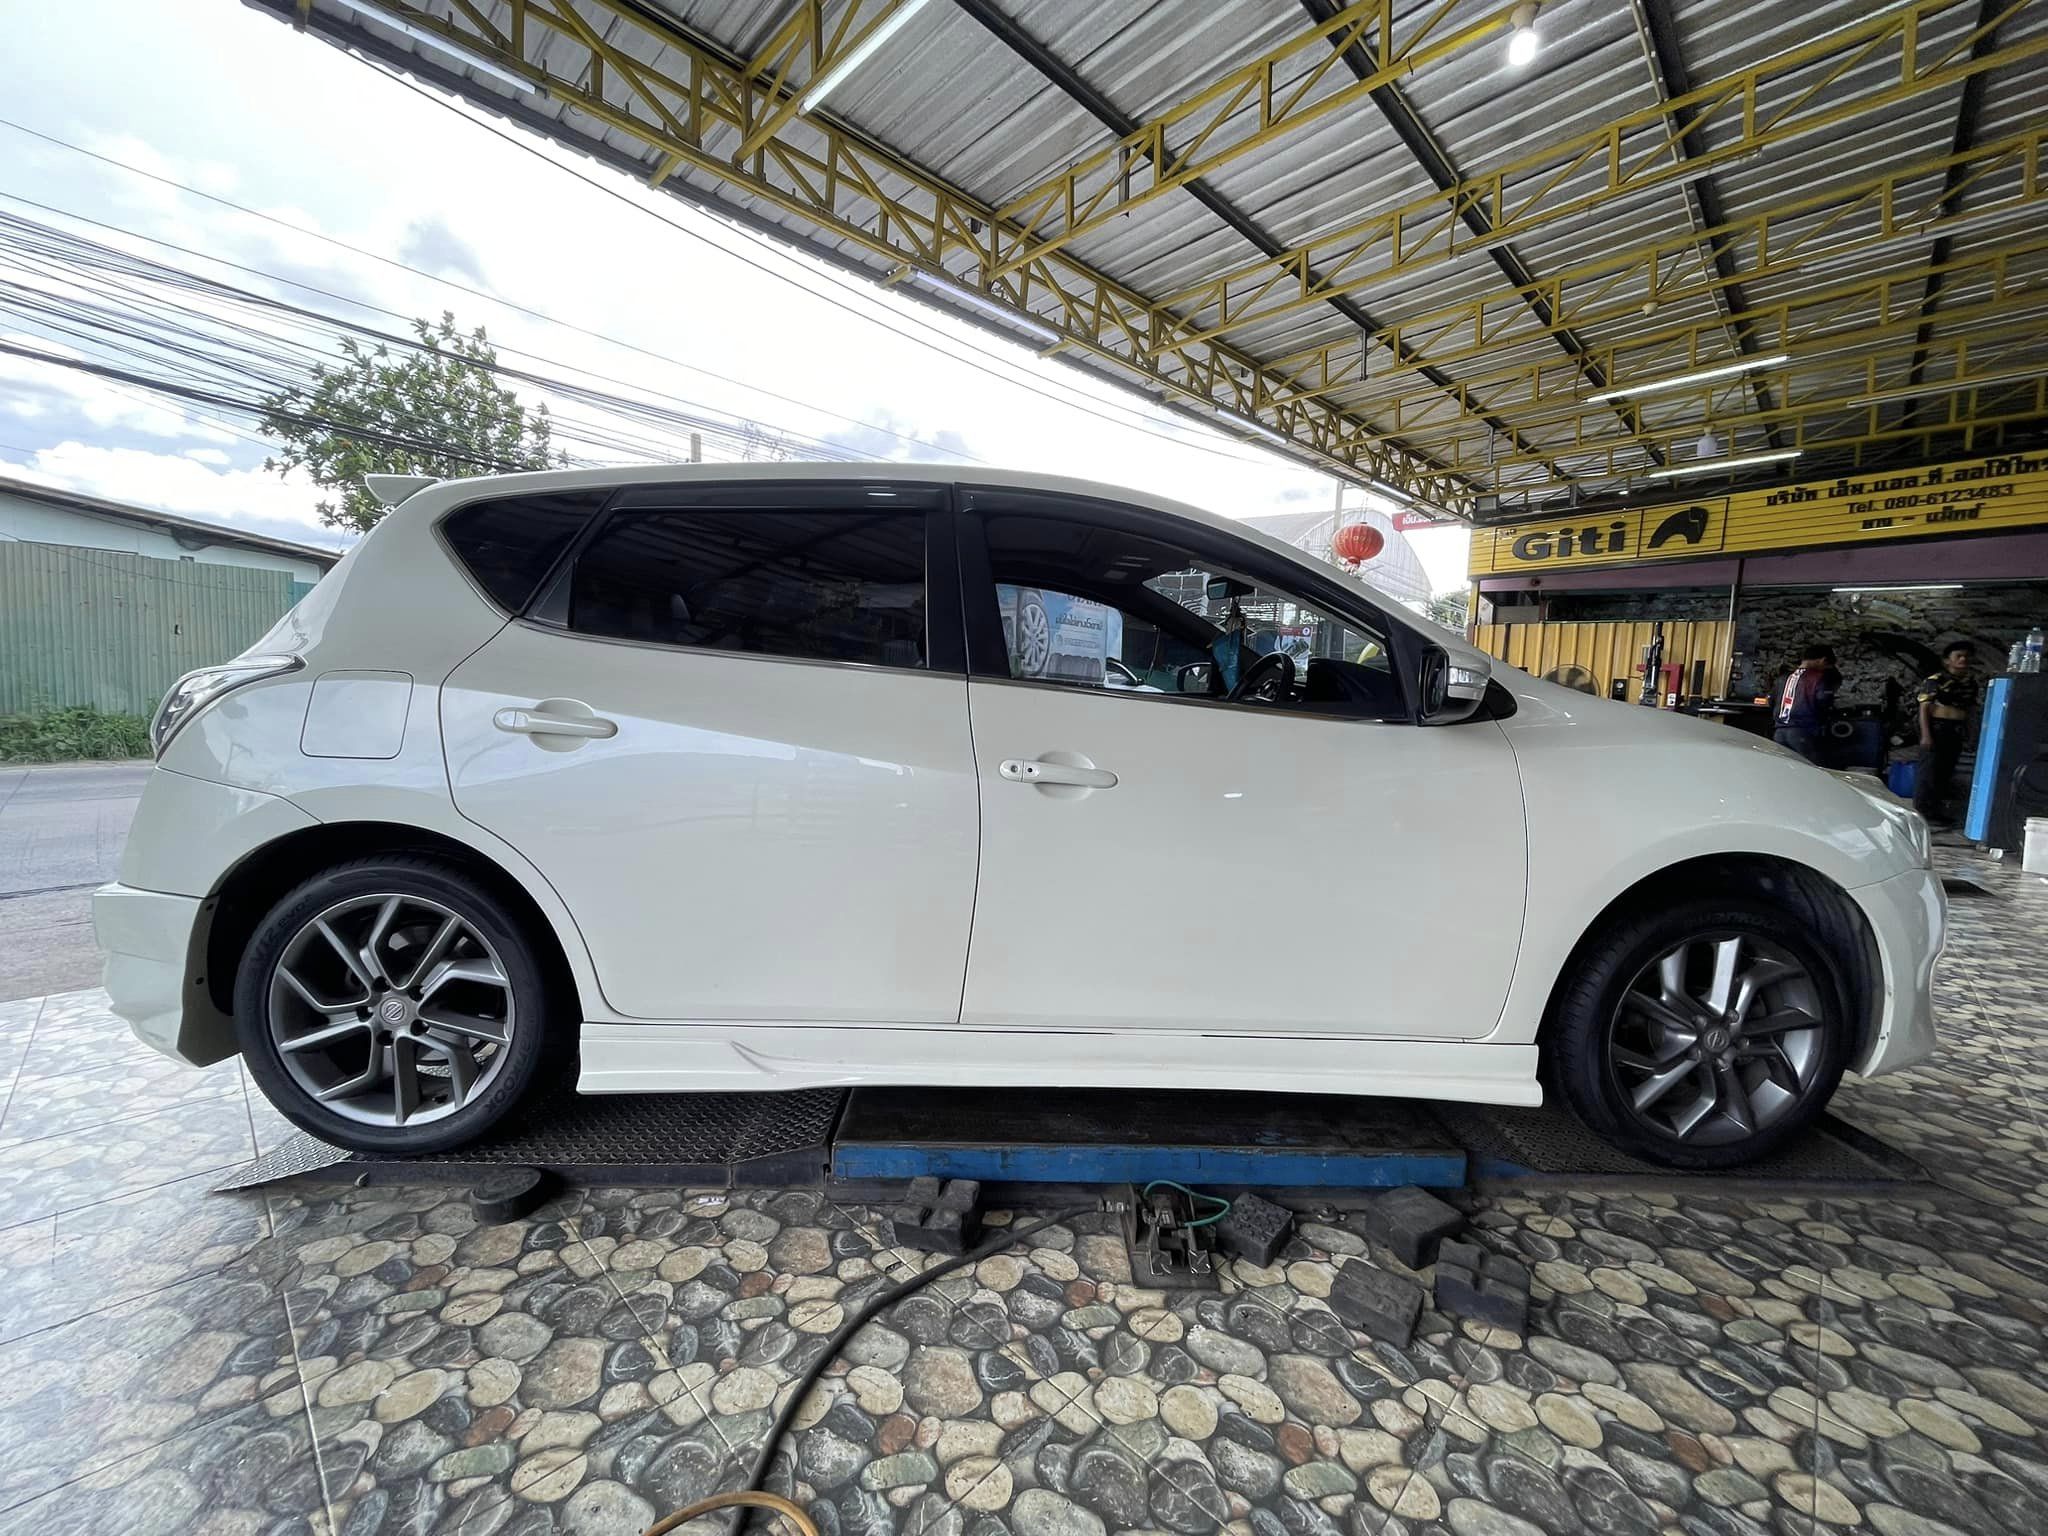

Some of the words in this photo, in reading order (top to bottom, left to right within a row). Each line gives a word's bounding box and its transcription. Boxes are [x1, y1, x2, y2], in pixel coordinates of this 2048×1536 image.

[1766, 486, 1819, 507] บริษัท
[1846, 499, 1882, 515] Tel.
[1884, 483, 2015, 511] 080-6123483
[1511, 521, 1627, 561] Giti
